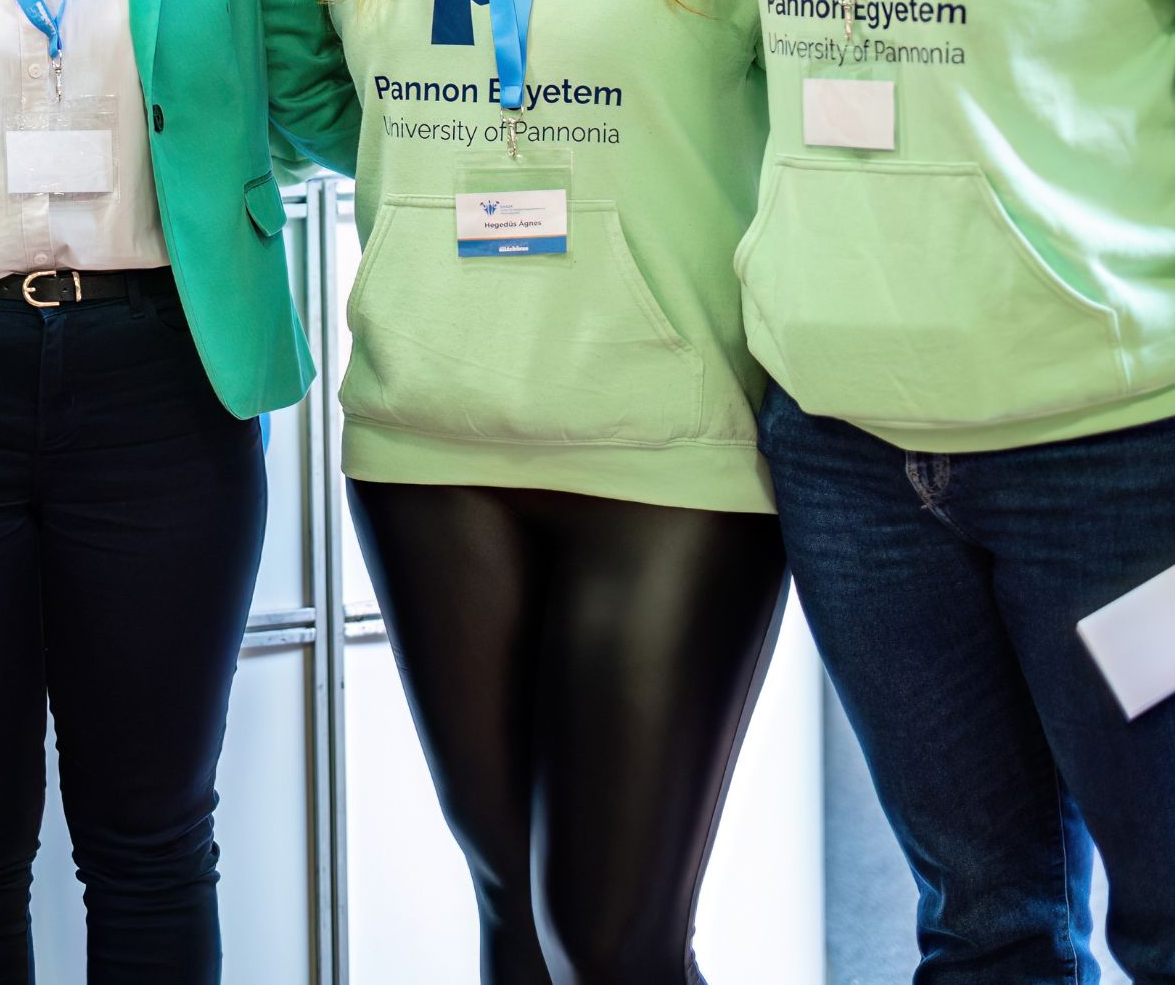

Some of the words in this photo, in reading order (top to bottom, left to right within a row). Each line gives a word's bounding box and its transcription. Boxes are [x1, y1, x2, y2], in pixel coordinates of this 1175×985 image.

[768, 32, 848, 66] University
[854, 39, 870, 62] of
[875, 40, 965, 64] Pannonia
[374, 75, 478, 103] Pannon
[488, 78, 622, 111] Eyetem
[484, 121, 508, 142] of
[514, 121, 620, 144] Pannonia
